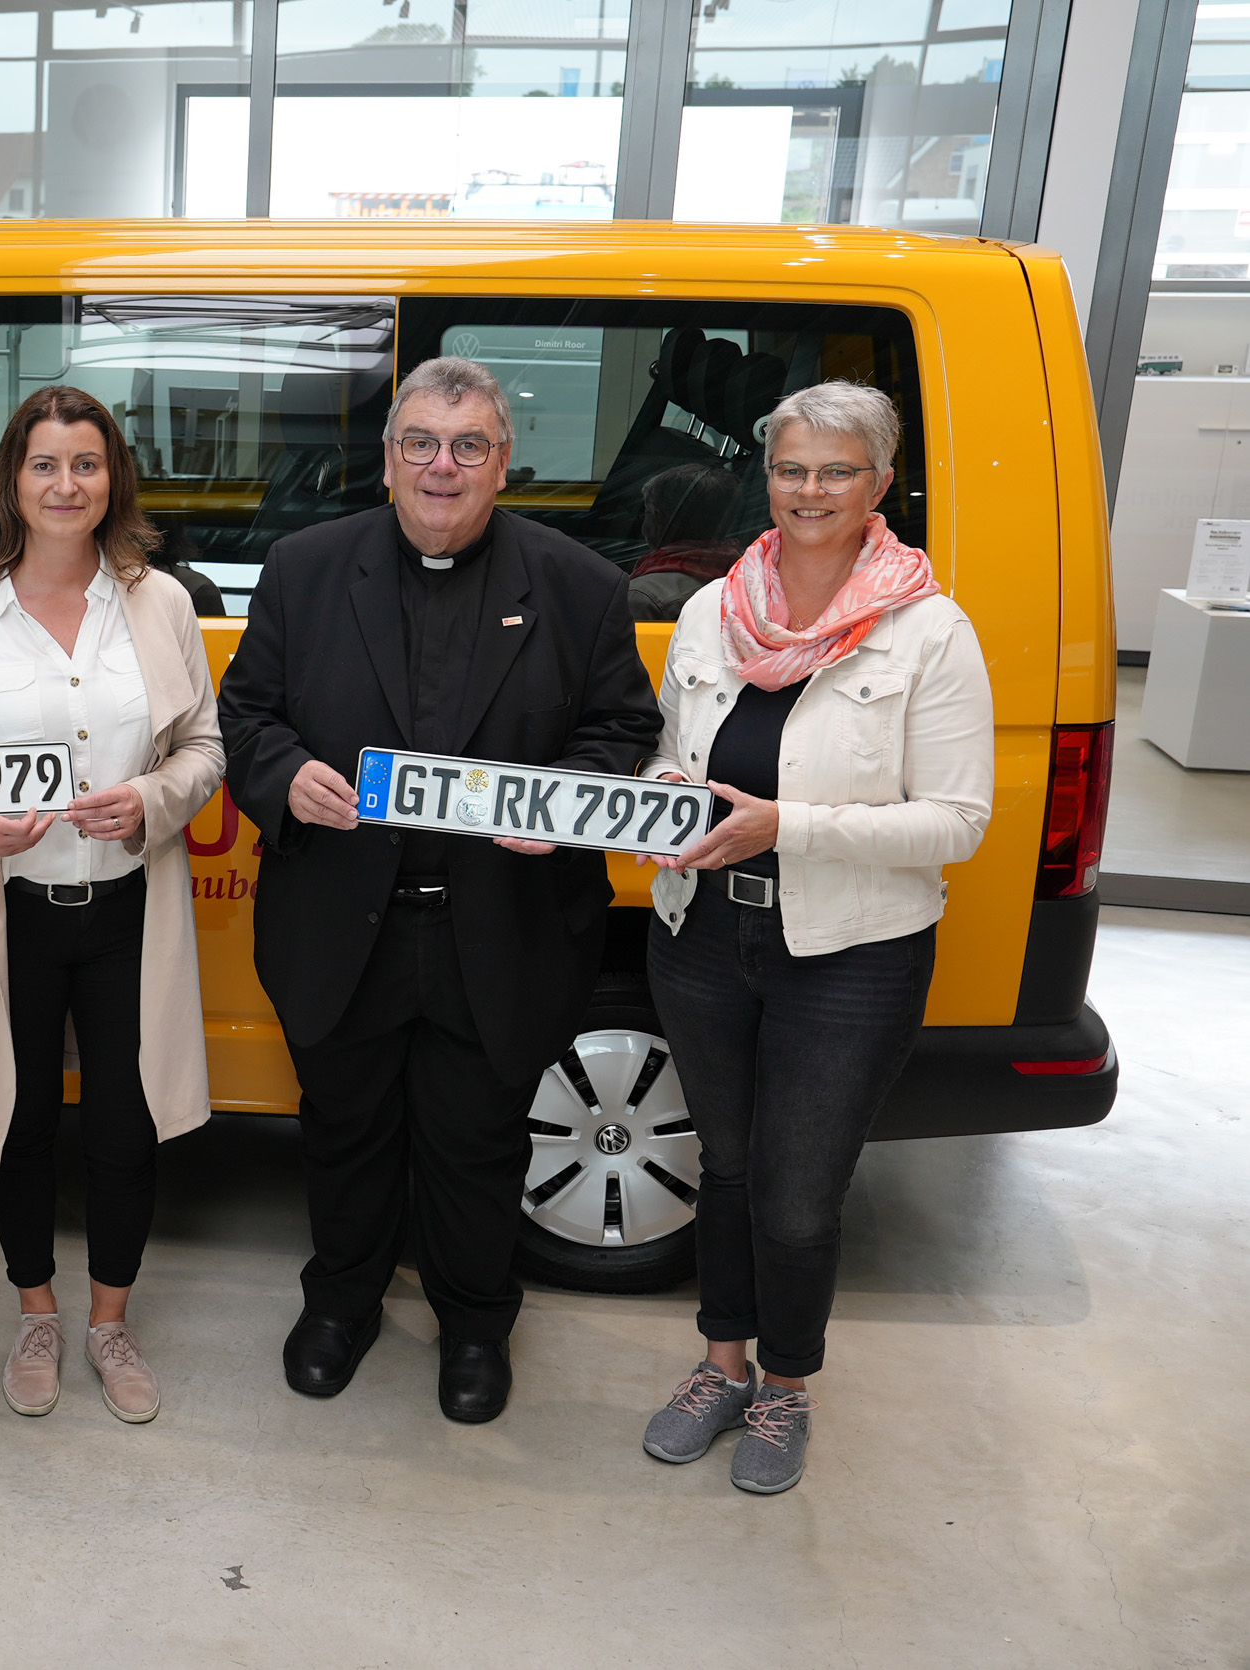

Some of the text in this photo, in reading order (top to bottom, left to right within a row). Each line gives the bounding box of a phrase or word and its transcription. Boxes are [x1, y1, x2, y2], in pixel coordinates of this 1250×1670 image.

[535, 340, 586, 349] Dimitri Roor
[365, 793, 378, 809] D
[395, 763, 461, 820] GT
[493, 774, 561, 833] RK
[572, 783, 701, 846] 7979
